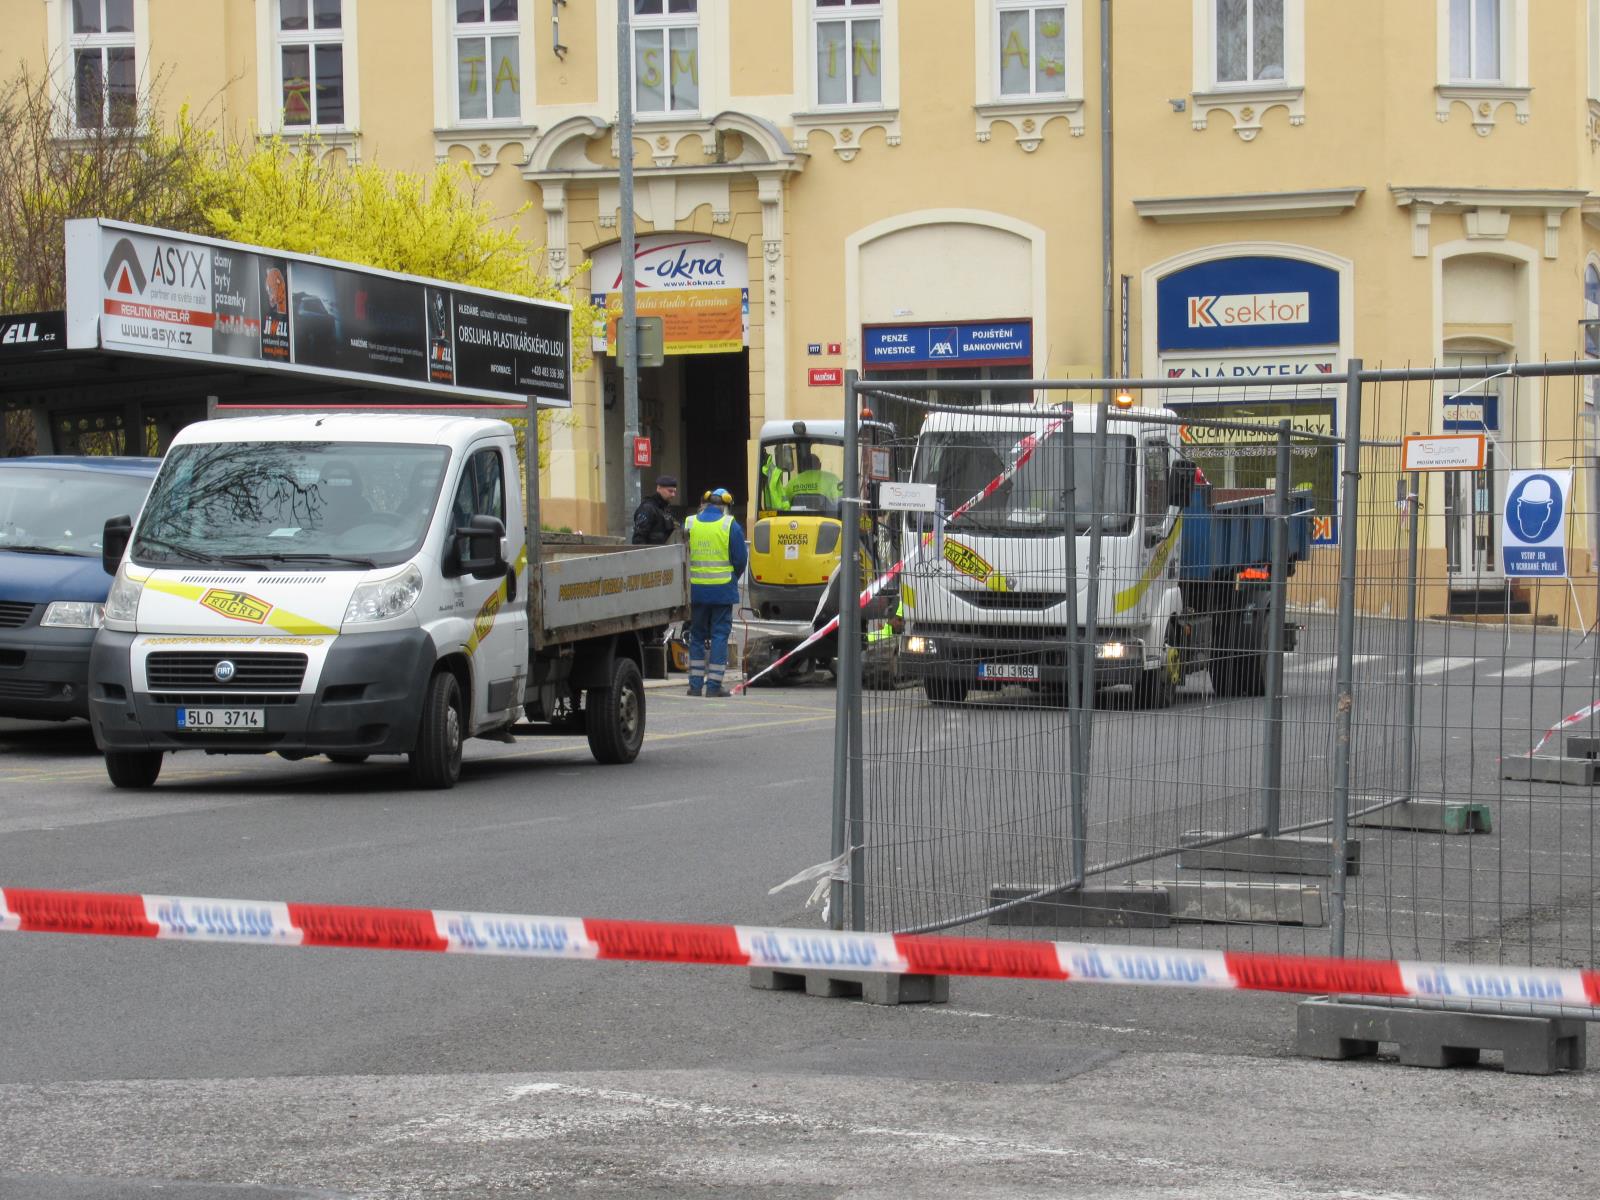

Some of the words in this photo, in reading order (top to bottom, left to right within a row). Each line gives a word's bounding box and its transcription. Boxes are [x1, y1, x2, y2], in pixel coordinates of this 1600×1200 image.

[151, 246, 206, 290] ASYX
[214, 252, 232, 275] domy
[214, 269, 231, 293] byty
[663, 280, 726, 288] www.kokna.cz
[215, 291, 246, 313] pozemky
[1224, 295, 1305, 324] sektor
[121, 322, 193, 346] www.asyx.cz
[881, 334, 909, 343] PENZE
[972, 328, 1014, 340] POJIŠTĚNÍ
[458, 326, 492, 346] OBSLUHA
[493, 330, 550, 355] PLASTIKÁŘSKÉHO
[550, 341, 564, 357] LISU
[929, 342, 953, 355] AXA
[962, 340, 1024, 352] BANKOVNICTVÍ
[874, 346, 916, 356] INVESTICE
[1520, 552, 1536, 560] VSTUP
[1537, 551, 1546, 560] JEN
[217, 667, 231, 675] FIAT
[224, 711, 258, 726] 3714
